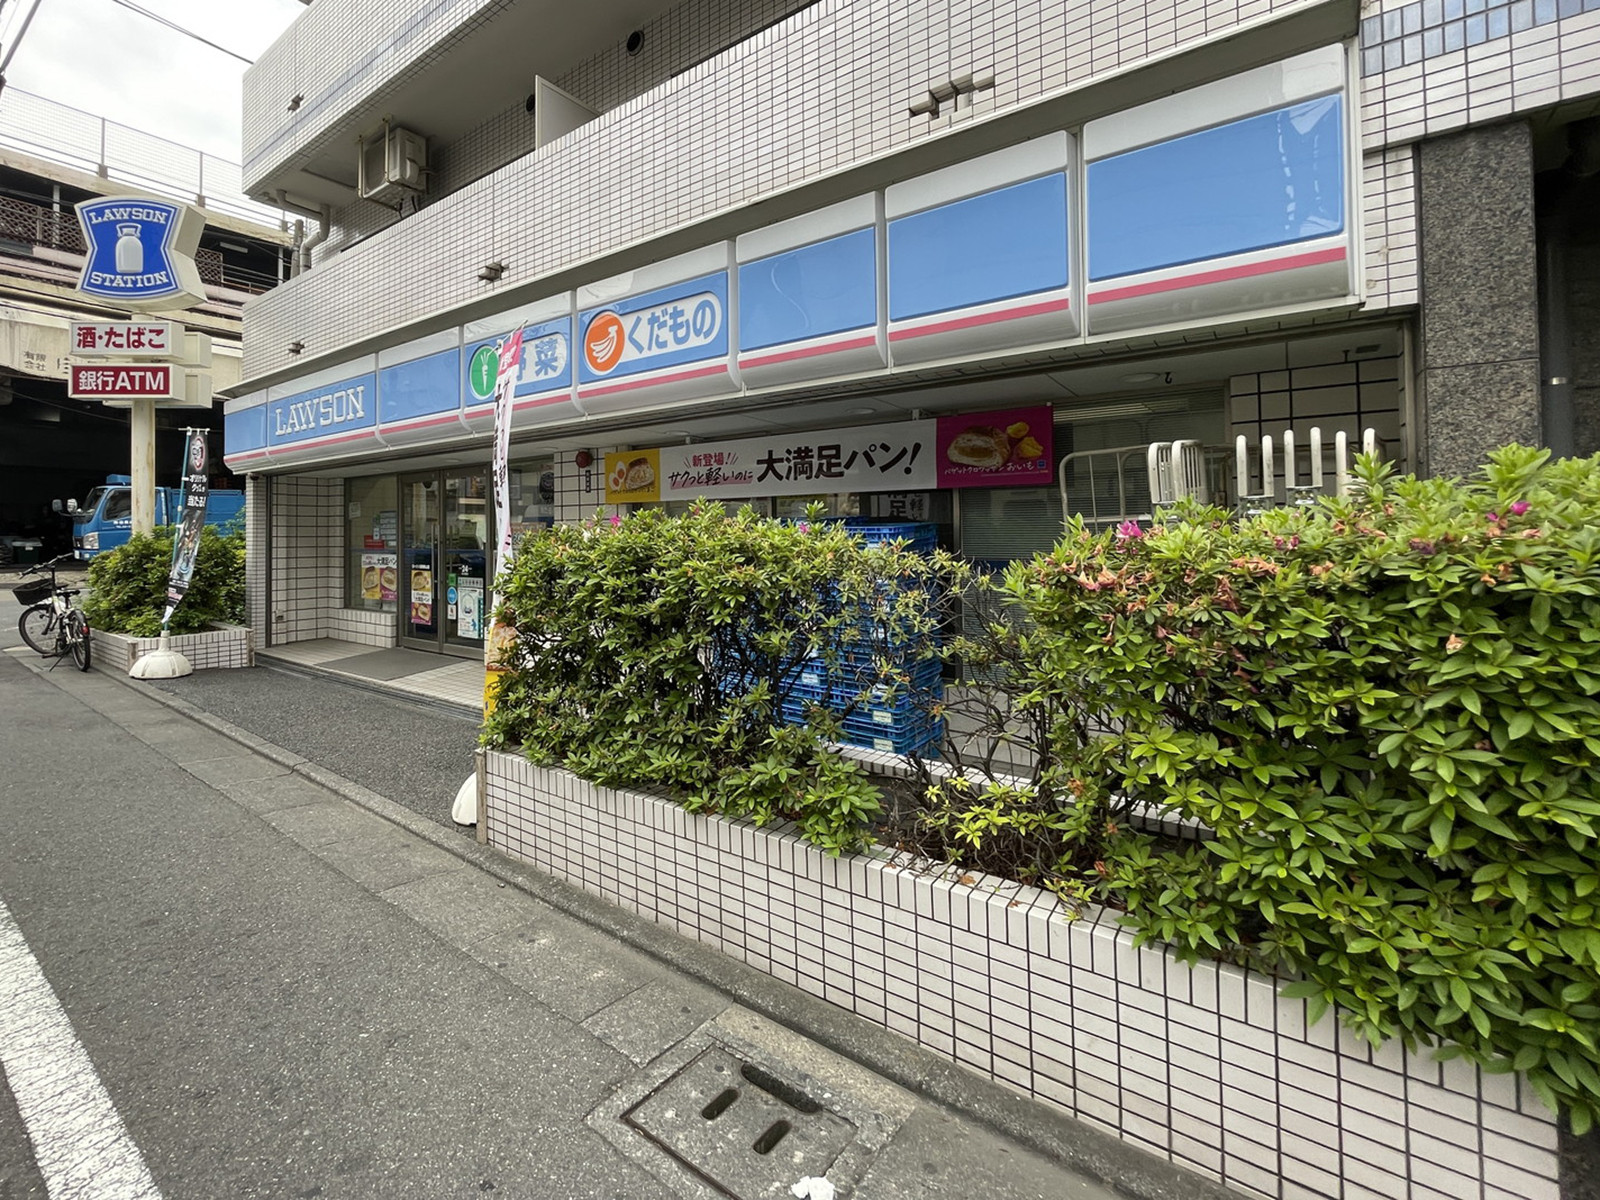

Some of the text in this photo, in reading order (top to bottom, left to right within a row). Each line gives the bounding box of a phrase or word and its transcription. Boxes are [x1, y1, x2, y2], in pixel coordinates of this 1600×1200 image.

[89, 207, 168, 225] LAWSON
[90, 270, 169, 288] STATION
[628, 298, 717, 354] くだもの
[76, 326, 165, 349] 酒・たばこ
[78, 370, 164, 391] 銀行ATM
[275, 385, 365, 436] LAWSON
[756, 442, 922, 482] 大満足パン!
[1006, 461, 1035, 471] おいも
[668, 467, 754, 488] サクっと軽いのに
